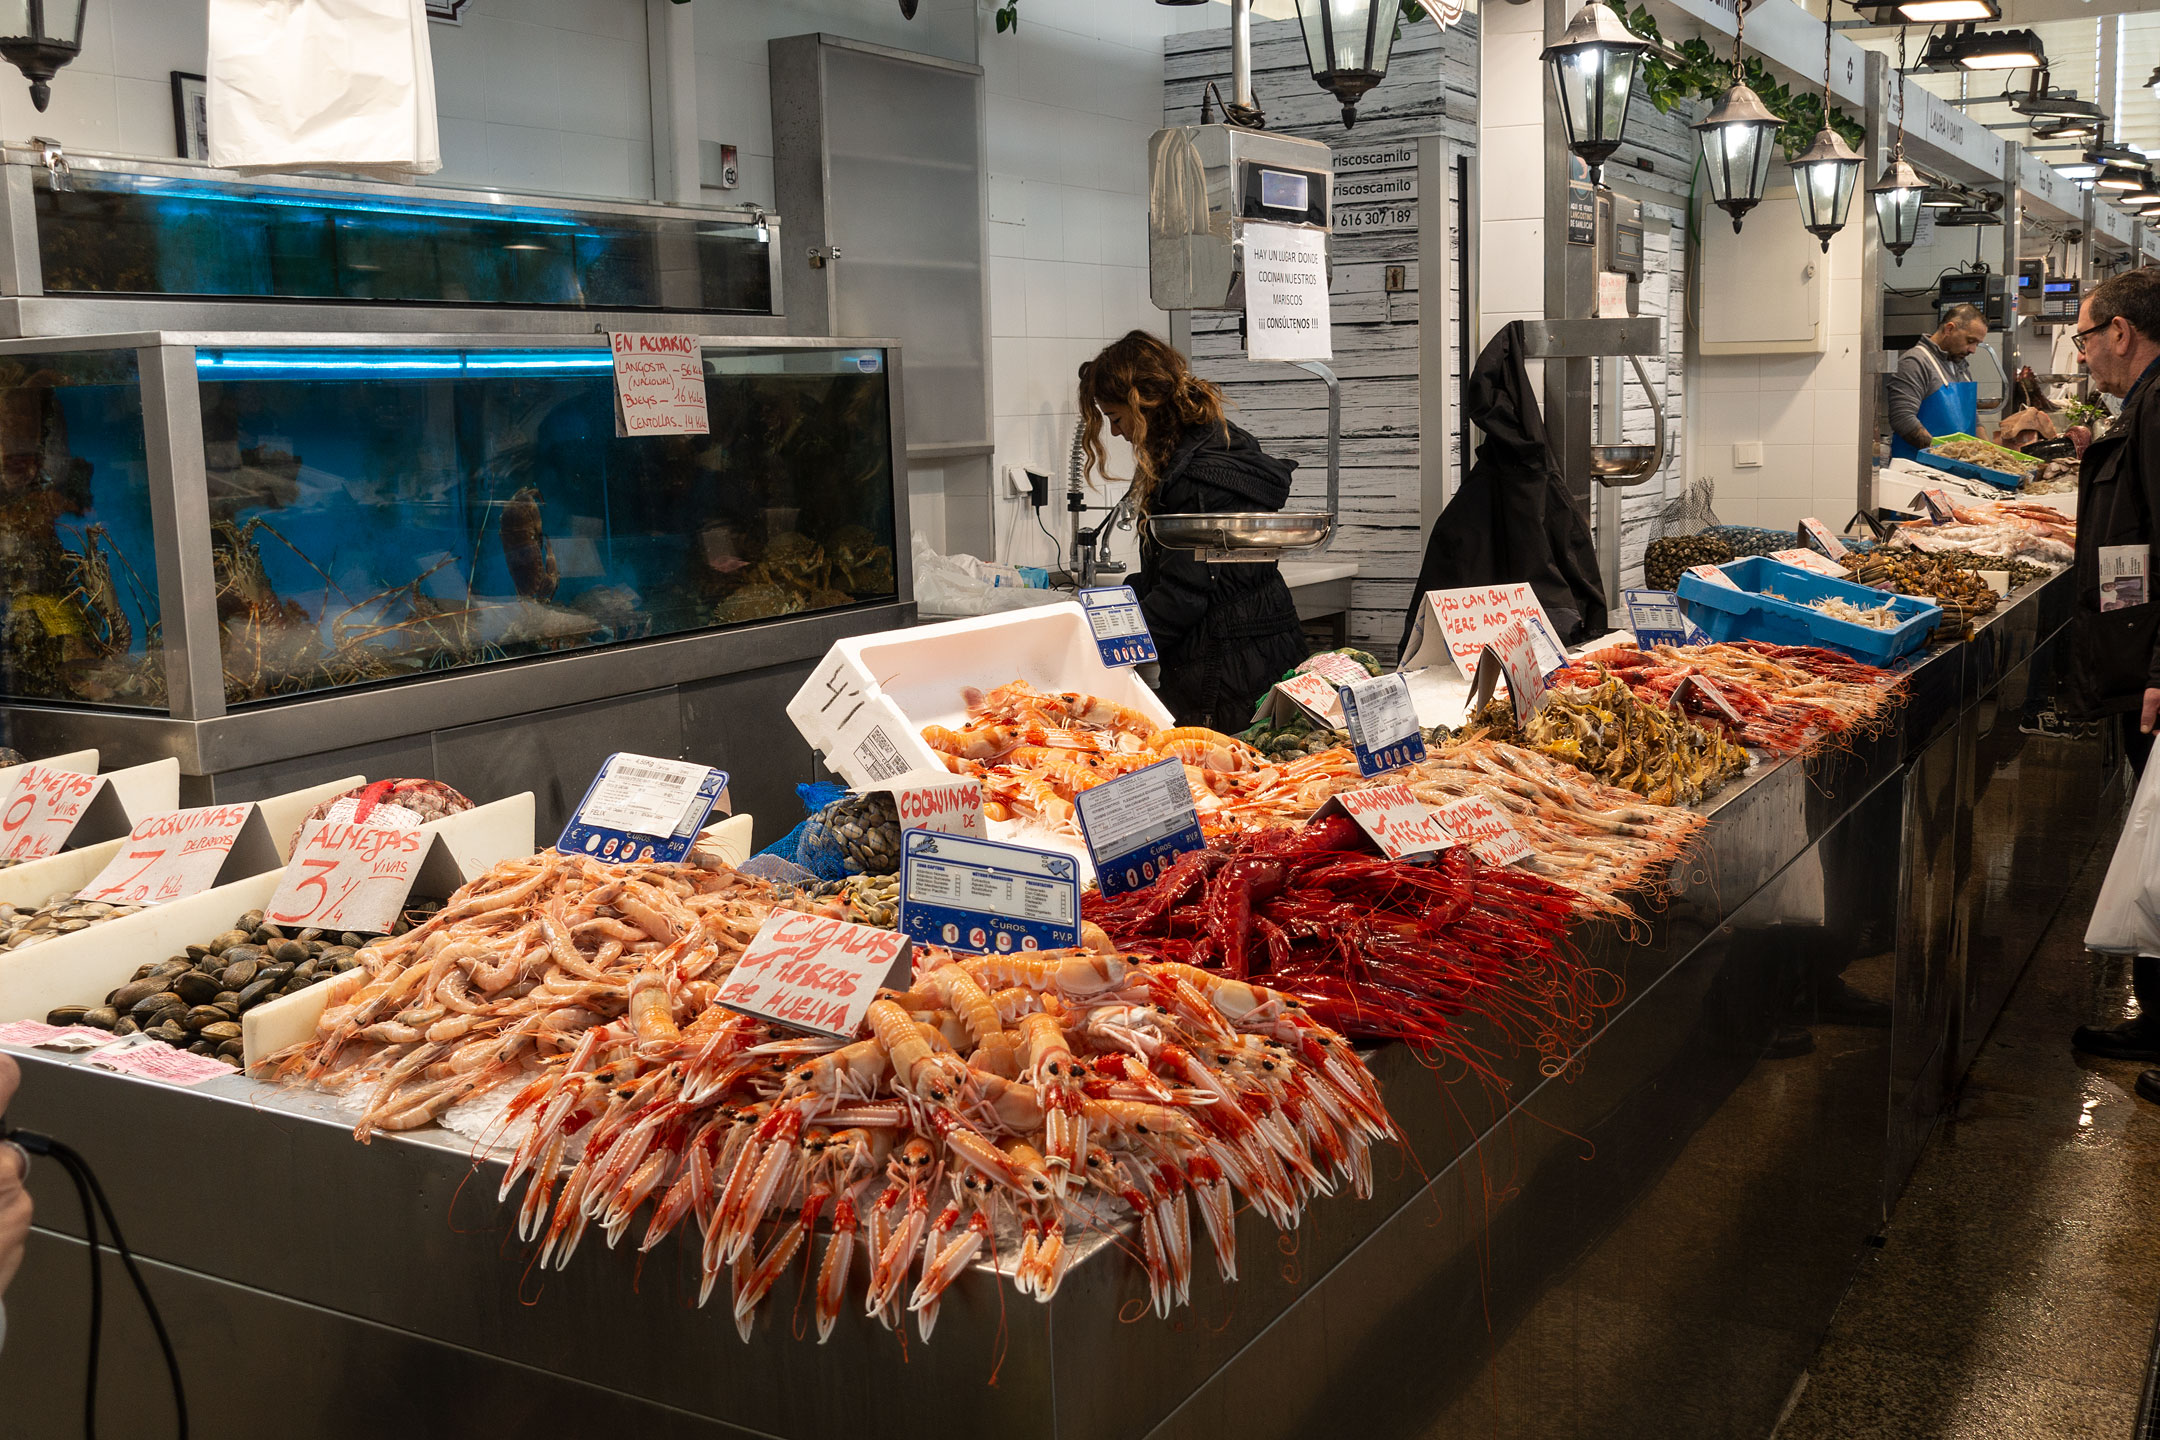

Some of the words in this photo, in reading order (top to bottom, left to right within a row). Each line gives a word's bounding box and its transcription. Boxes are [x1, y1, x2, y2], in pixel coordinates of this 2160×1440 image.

[1341, 213, 1362, 226] 616
[1365, 211, 1387, 225] 307
[1391, 209, 1411, 223] 189
[1254, 249, 1267, 260] HAY
[1269, 250, 1278, 261] UN
[1278, 251, 1296, 262] LUGAR
[1298, 252, 1319, 264] DONDE
[1258, 271, 1284, 283] COCINAN
[1284, 273, 1317, 285] NUESTROS
[1272, 294, 1303, 305] MARISCOS
[1266, 315, 1310, 329] CONSÚLTENOS
[615, 334, 633, 352] EN
[619, 360, 667, 377] LANGOSTA
[681, 363, 692, 377] 56
[628, 374, 675, 391] (NACIONAL)
[674, 384, 686, 402] 16
[630, 414, 677, 430] CENTOLLAS
[685, 414, 694, 428] 14
[1462, 593, 1486, 608] CAN
[1488, 590, 1511, 608] BUY
[1514, 587, 1525, 600] IT
[1447, 616, 1477, 634] HERE
[1483, 612, 1508, 627] AND
[13, 766, 97, 807] ALMEJAS
[901, 784, 982, 819] COQUINAS
[131, 807, 245, 842] COQUINAS
[962, 813, 975, 829] DE
[306, 823, 421, 862] ALMEJAS
[372, 858, 407, 874] VIVAS
[272, 859, 340, 923] 3
[772, 915, 903, 964] CIGALAS
[989, 918, 1029, 934] €UROS.
[1053, 930, 1074, 943] P.V.P.
[760, 986, 851, 1032] HUELVA
